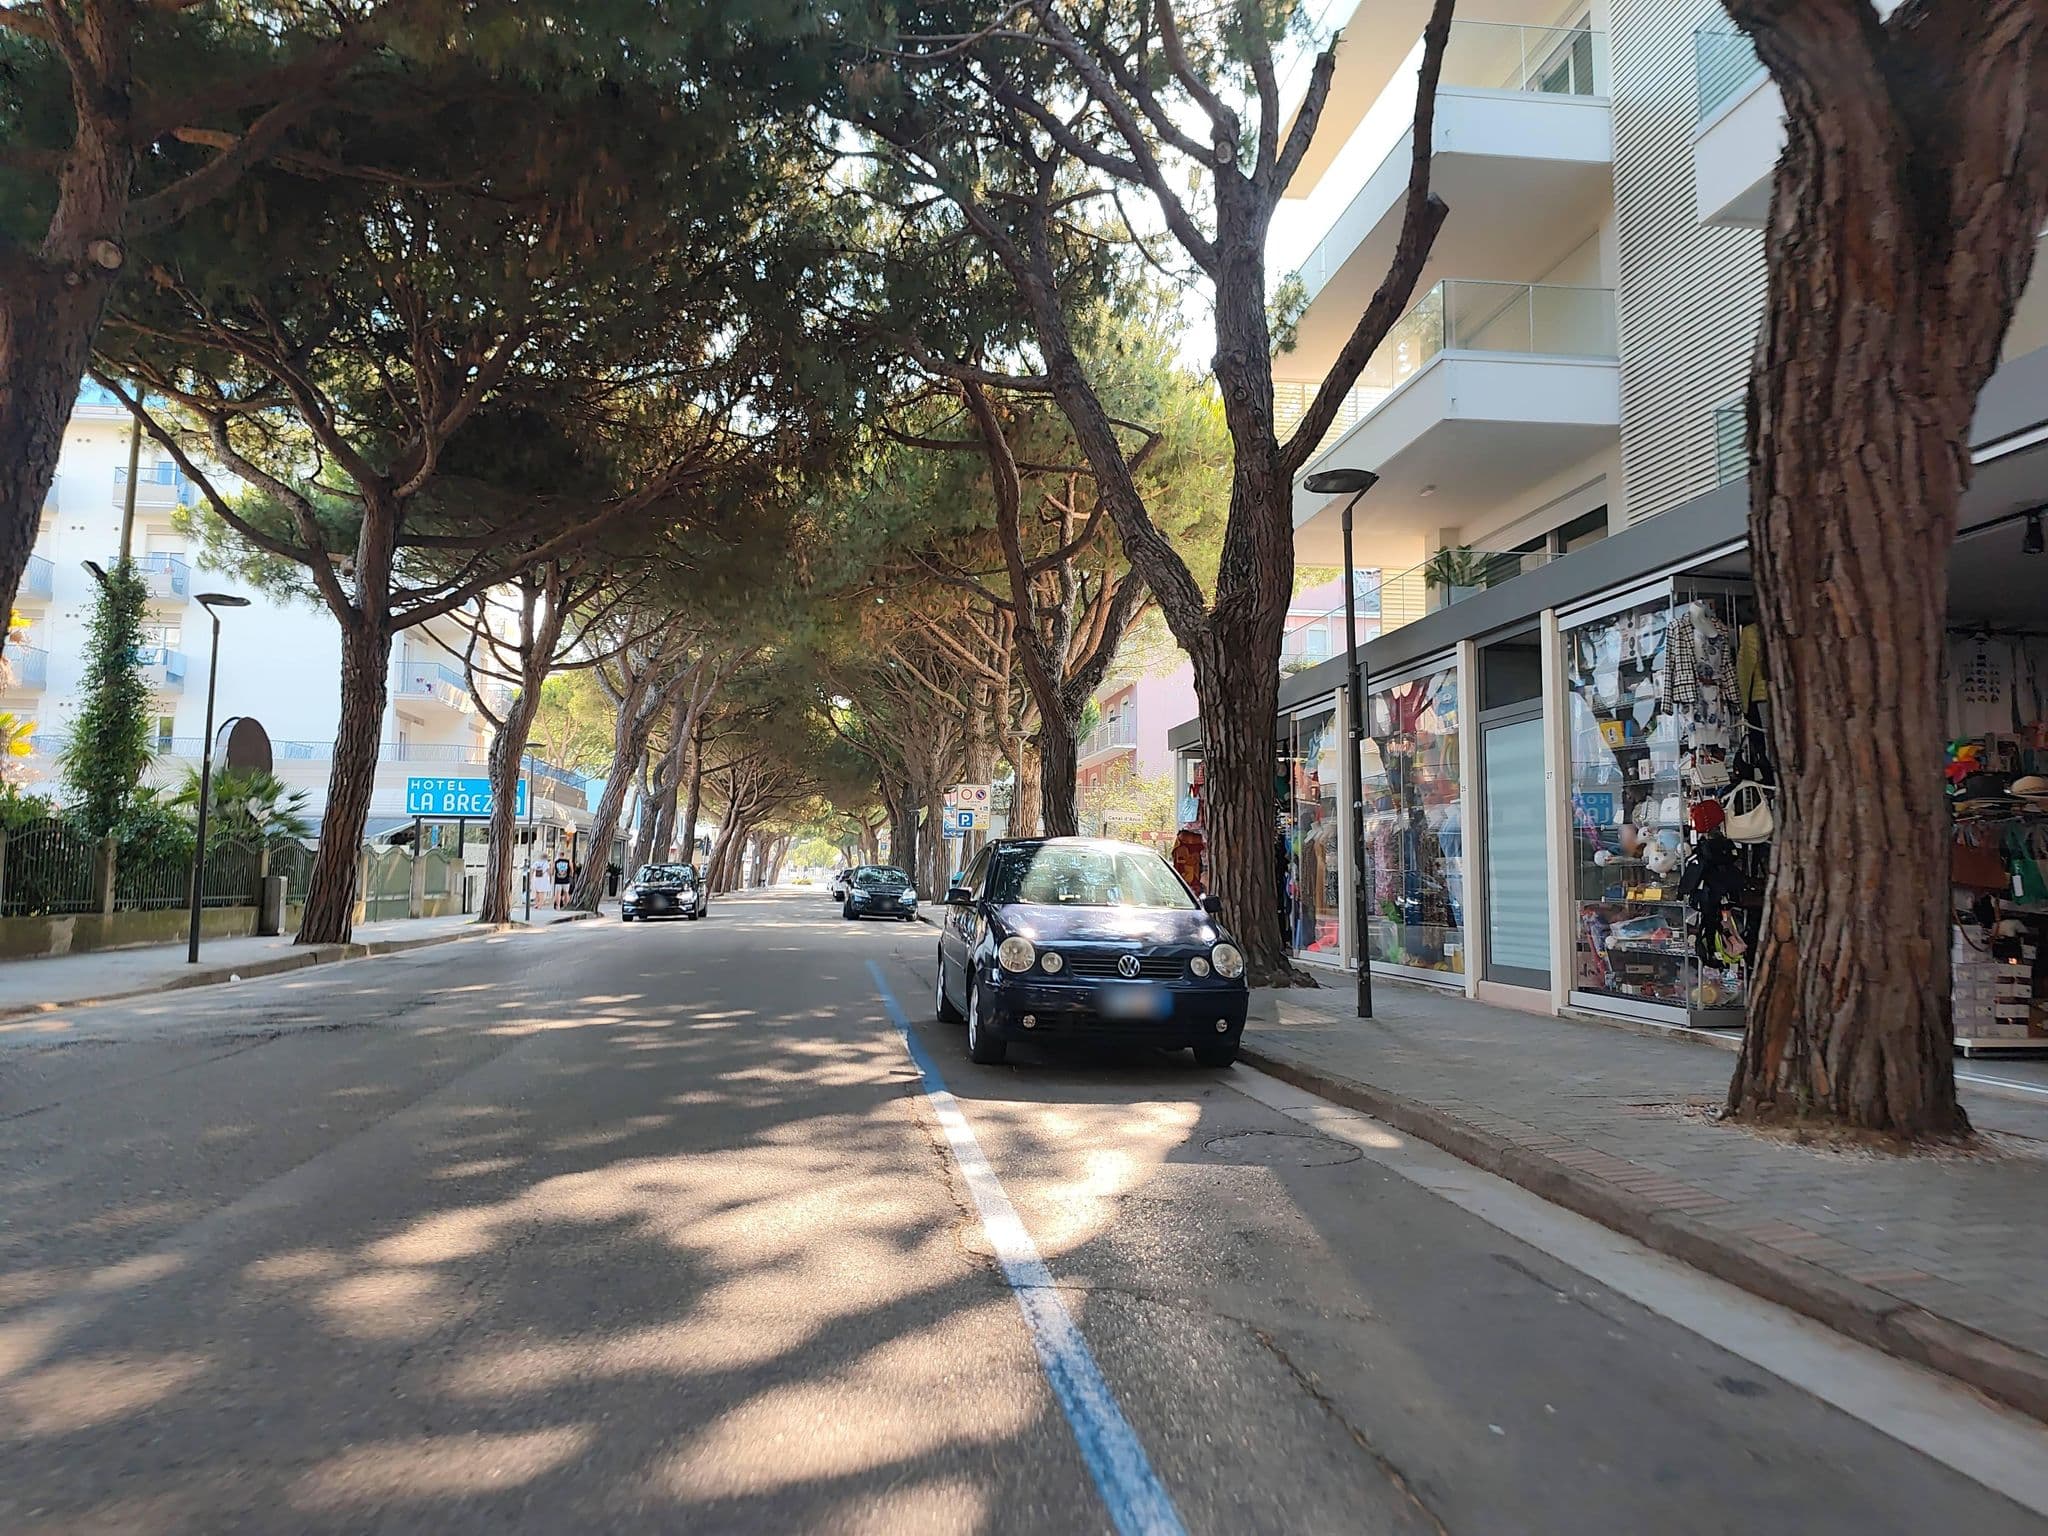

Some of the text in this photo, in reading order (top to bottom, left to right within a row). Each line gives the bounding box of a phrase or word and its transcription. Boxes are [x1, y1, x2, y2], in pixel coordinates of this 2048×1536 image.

[411, 780, 466, 791] HOTEL
[409, 792, 521, 813] LA BREZ
[961, 815, 970, 826] P
